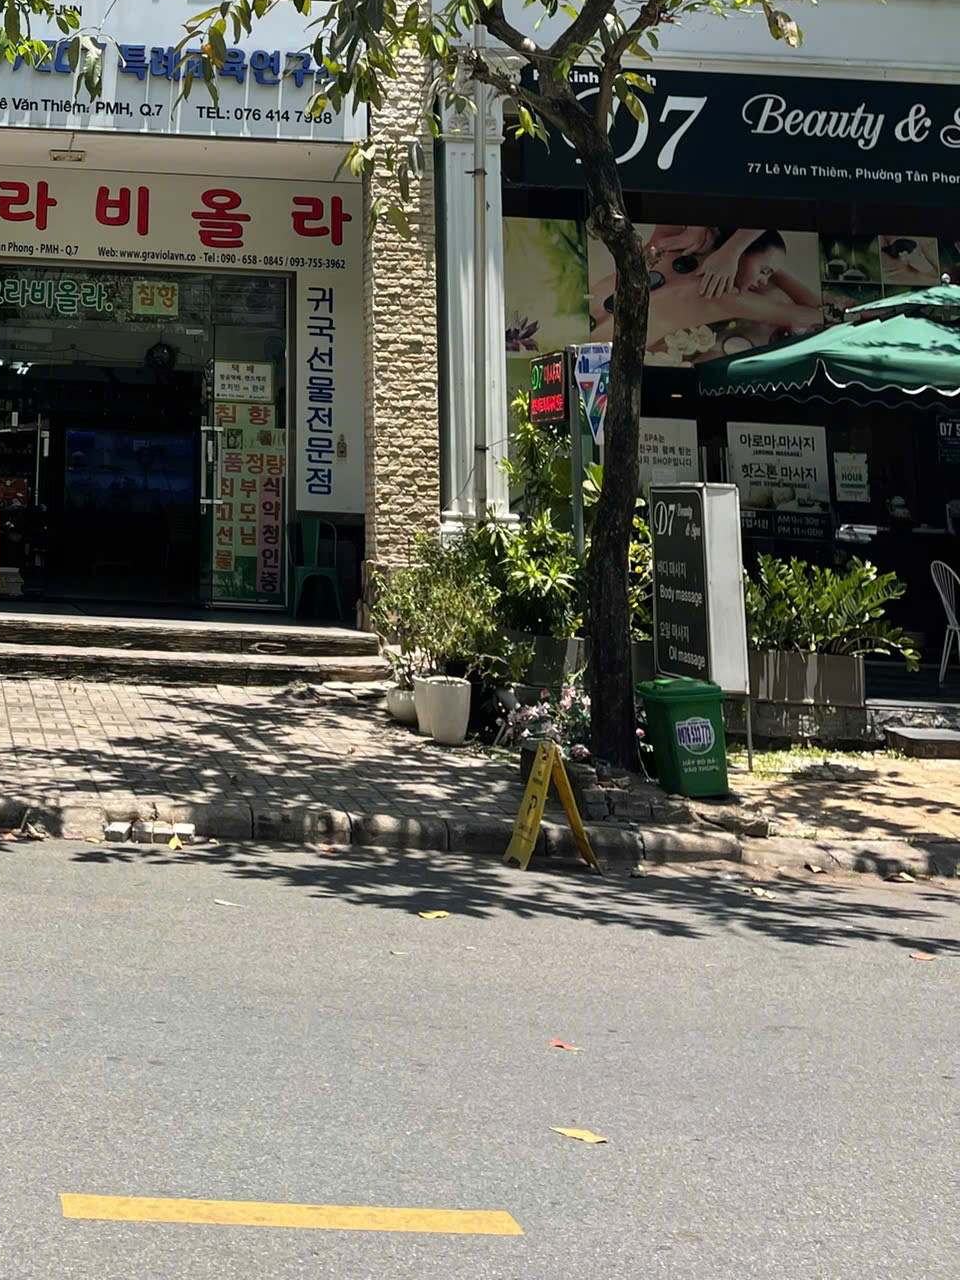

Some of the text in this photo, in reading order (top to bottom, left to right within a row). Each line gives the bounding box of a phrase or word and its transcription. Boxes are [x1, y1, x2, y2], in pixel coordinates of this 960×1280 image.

[12, 97, 38, 111] Văn
[95, 101, 133, 118] PMH,
[140, 104, 163, 117] Q.7
[196, 106, 230, 120] TEL:
[234, 108, 261, 121] 076
[265, 109, 290, 122] 414
[742, 93, 885, 150] Beauty
[894, 103, 932, 143] &
[747, 163, 761, 173] 77
[855, 168, 902, 183] Phường
[906, 170, 929, 183] Tân
[7, 242, 34, 255] Phong
[40, 244, 59, 254] PMH
[65, 245, 79, 257] Q.7
[98, 246, 119, 258] Web:
[119, 248, 196, 263] www.graviolavn.co
[220, 253, 236, 264] 090
[242, 254, 257, 265] 658
[263, 255, 284, 266] 0845
[290, 256, 345, 270] 093-755-3962
[305, 287, 336, 496] 귀국선물전문점
[739, 433, 815, 451] 아로마 마사지
[652, 456, 693, 467] SHOP입니다
[741, 463, 817, 482] 핫스톤 마사지
[841, 472, 863, 481] HOUR
[654, 501, 675, 537] D7
[660, 584, 702, 607] Body massage
[659, 622, 689, 643] 오일 마사지
[669, 646, 705, 670] Oil massage
